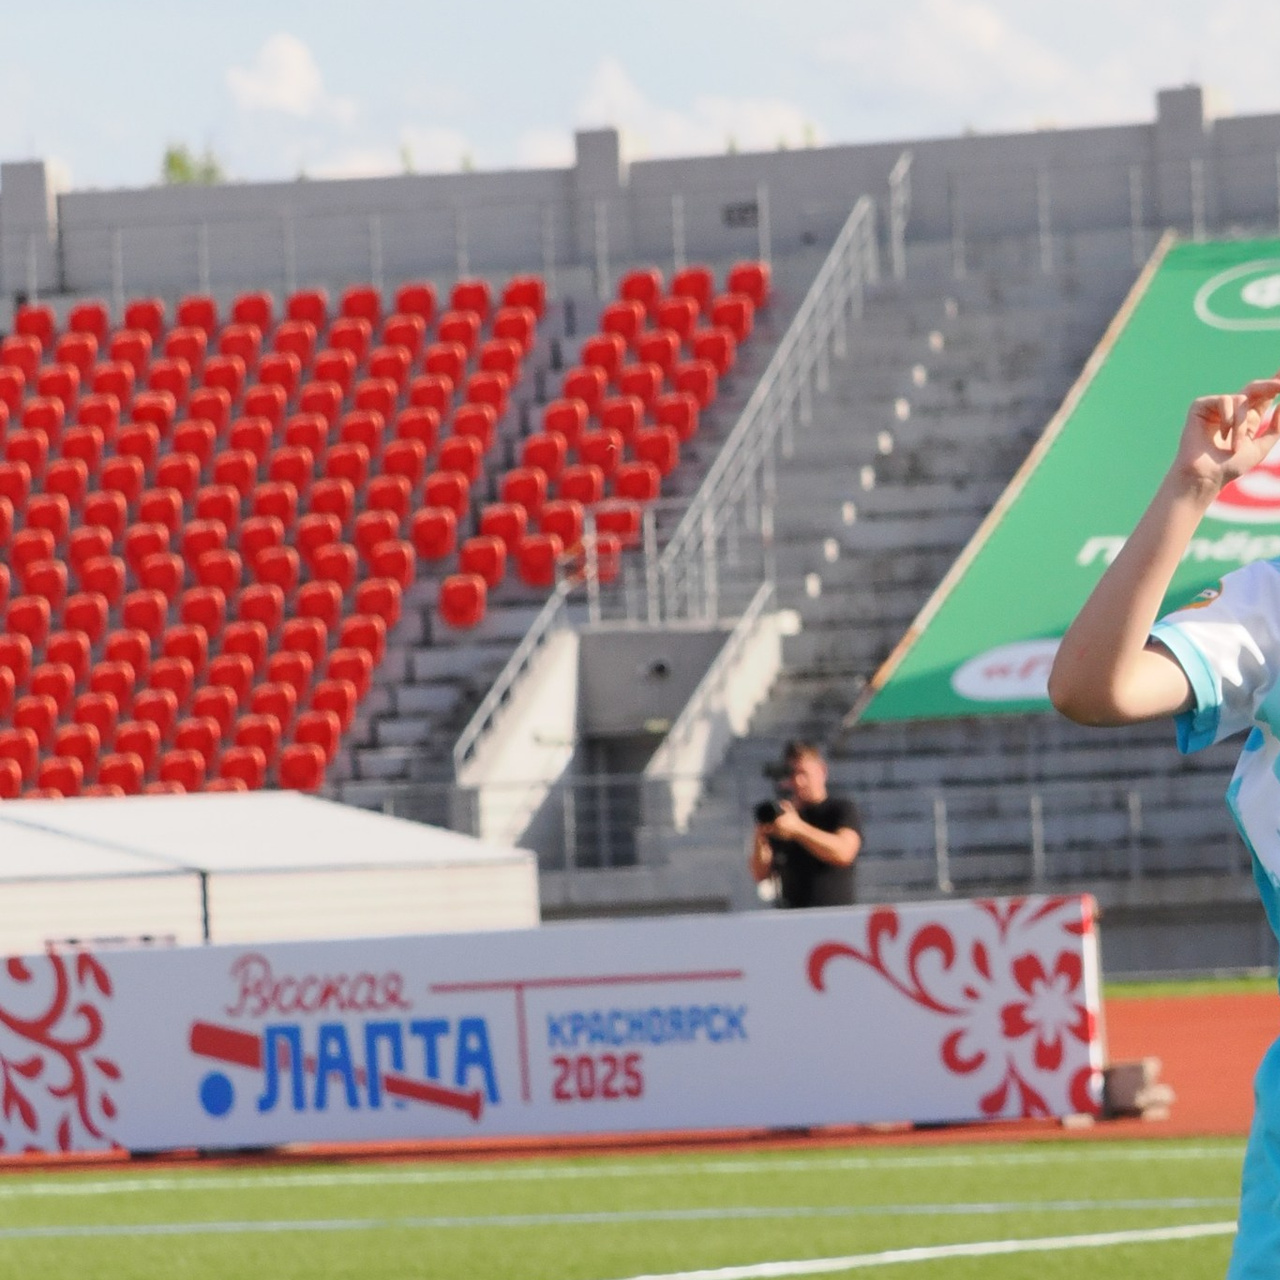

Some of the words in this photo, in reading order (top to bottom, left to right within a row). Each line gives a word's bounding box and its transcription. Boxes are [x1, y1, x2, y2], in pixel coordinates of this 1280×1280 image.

[546, 1004, 748, 1048] КРАСНОЯРСК
[257, 1017, 500, 1114] ЛАПТА
[552, 1051, 645, 1102] 2025
